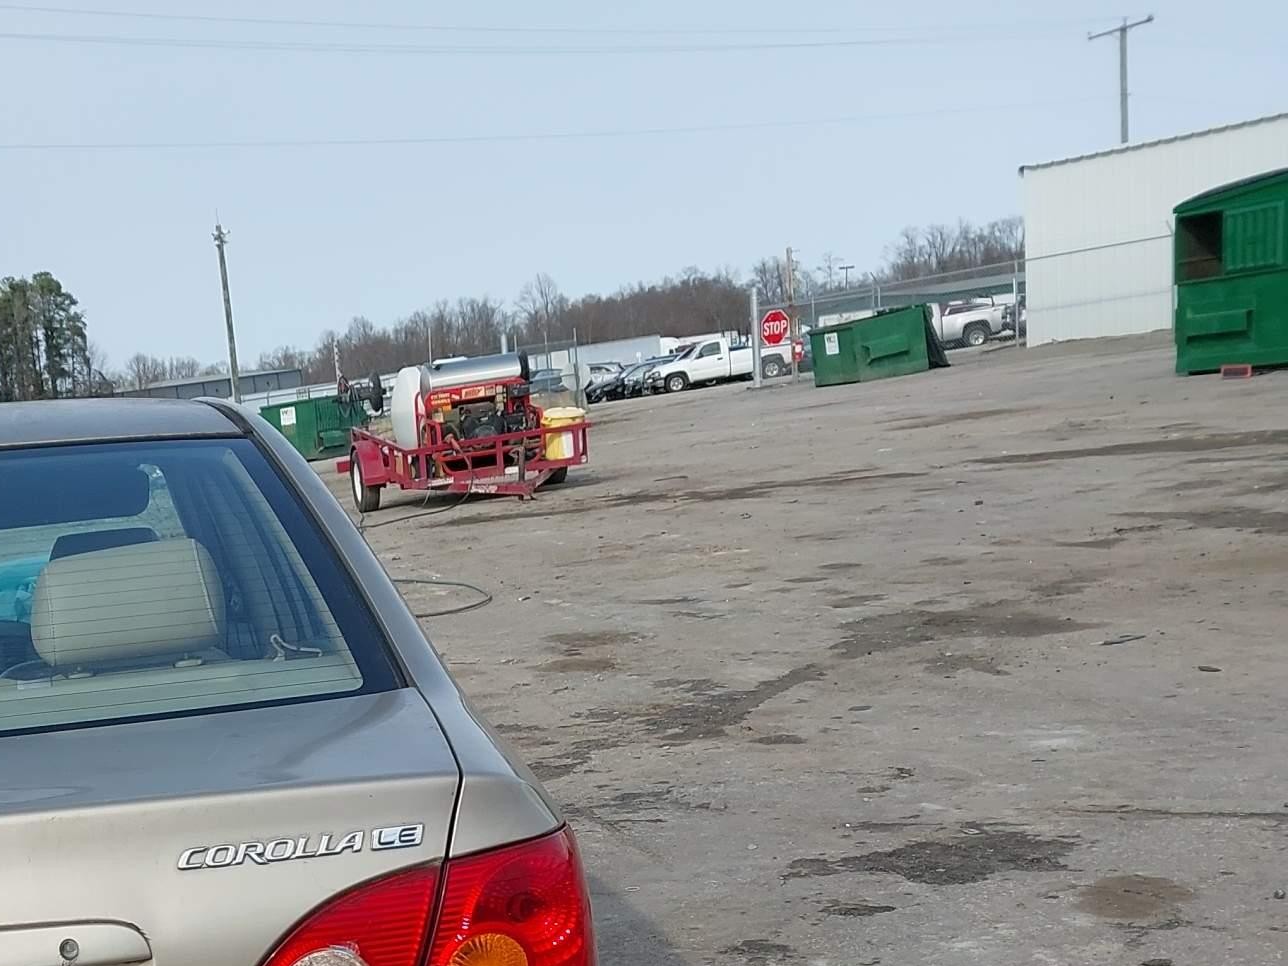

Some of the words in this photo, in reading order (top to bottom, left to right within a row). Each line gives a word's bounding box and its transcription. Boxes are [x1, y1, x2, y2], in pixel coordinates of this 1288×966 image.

[763, 320, 788, 337] STOP
[177, 831, 364, 870] COROLLA
[374, 825, 421, 848] LE
